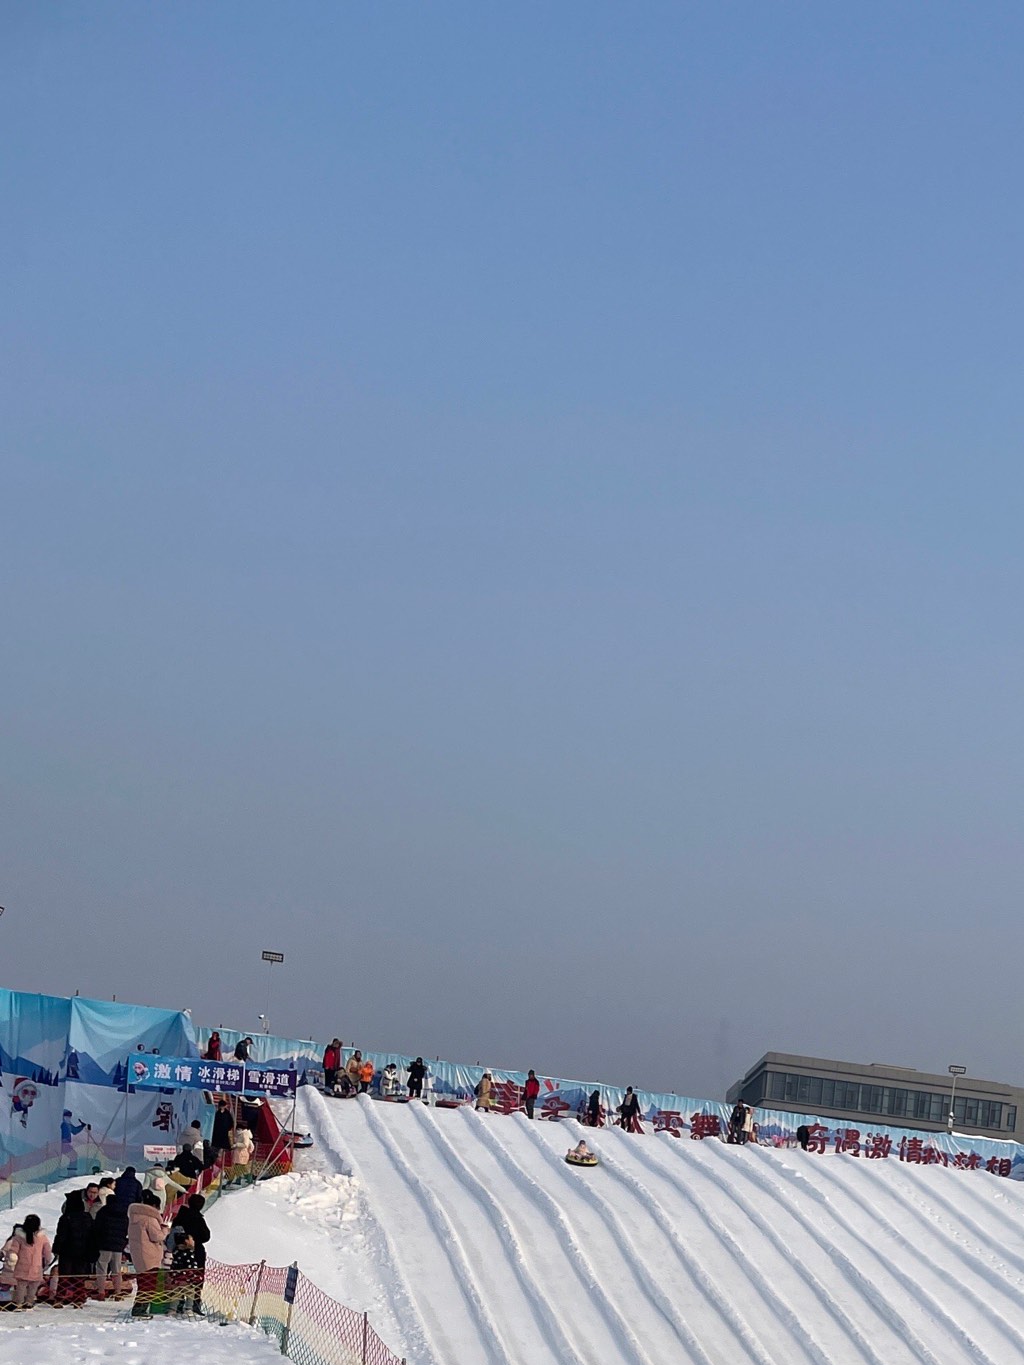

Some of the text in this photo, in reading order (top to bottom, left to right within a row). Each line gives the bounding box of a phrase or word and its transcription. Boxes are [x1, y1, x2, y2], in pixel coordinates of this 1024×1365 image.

[154, 1063, 192, 1081] 激情
[198, 1065, 240, 1081] 冰滑梯
[247, 1070, 290, 1086] 雪滑道
